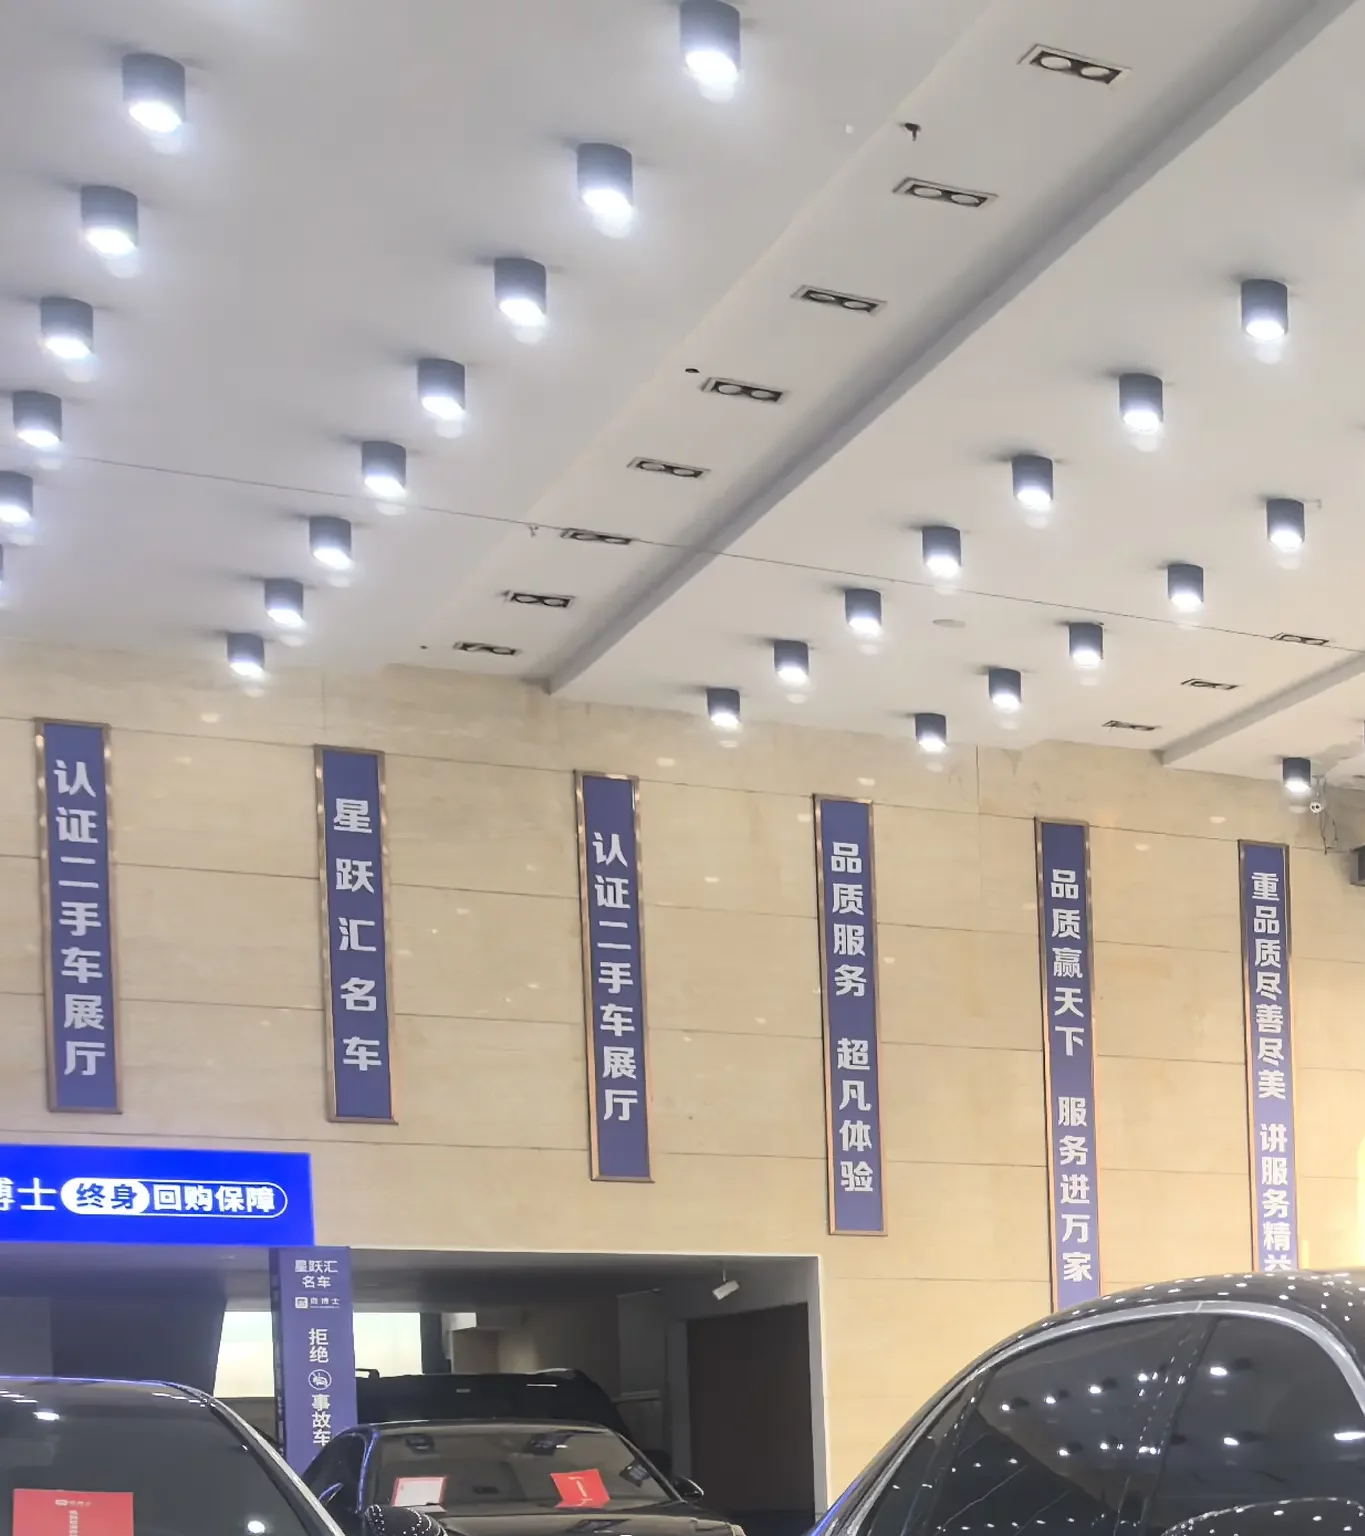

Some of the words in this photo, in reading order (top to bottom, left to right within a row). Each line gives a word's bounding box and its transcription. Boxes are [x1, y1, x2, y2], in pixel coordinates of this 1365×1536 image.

[54, 759, 105, 1076] 认证二手车展厅
[333, 798, 382, 1071] 星跃汇名车
[593, 832, 638, 1121] 认证二手车展厅
[830, 841, 866, 998] 品质服务
[1050, 869, 1084, 1057] 品质赢天下
[1251, 872, 1286, 1100] 重品质尽善尽美
[837, 1037, 873, 1192] 超凡体验
[1058, 1096, 1092, 1283] 服务进万家
[75, 1183, 137, 1209] 终身
[153, 1185, 276, 1213] 回购保障
[295, 1260, 338, 1273] 星跃汇
[302, 1275, 331, 1288] 名车
[309, 1328, 329, 1364] 拒绝
[311, 1394, 331, 1447] 事故车
